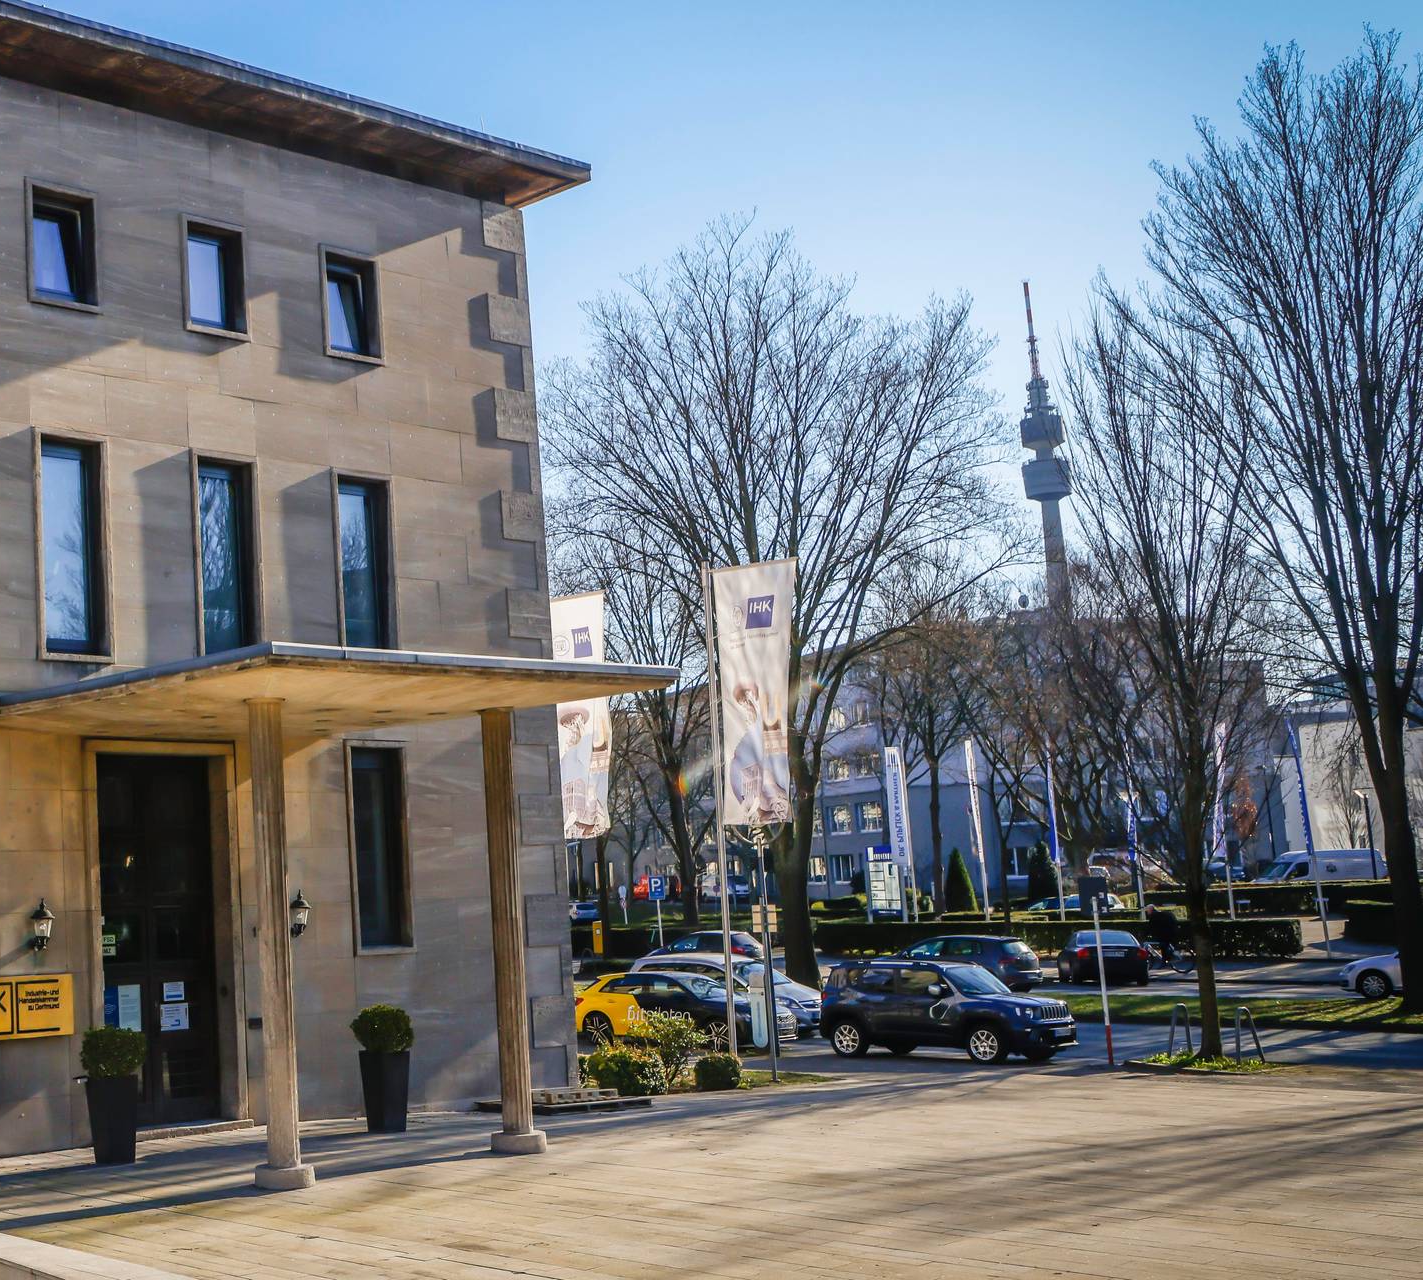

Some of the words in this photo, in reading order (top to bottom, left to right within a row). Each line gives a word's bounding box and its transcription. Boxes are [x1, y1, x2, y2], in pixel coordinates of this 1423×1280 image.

[749, 600, 772, 614] IHK
[574, 631, 591, 645] IHK
[651, 878, 661, 892] P
